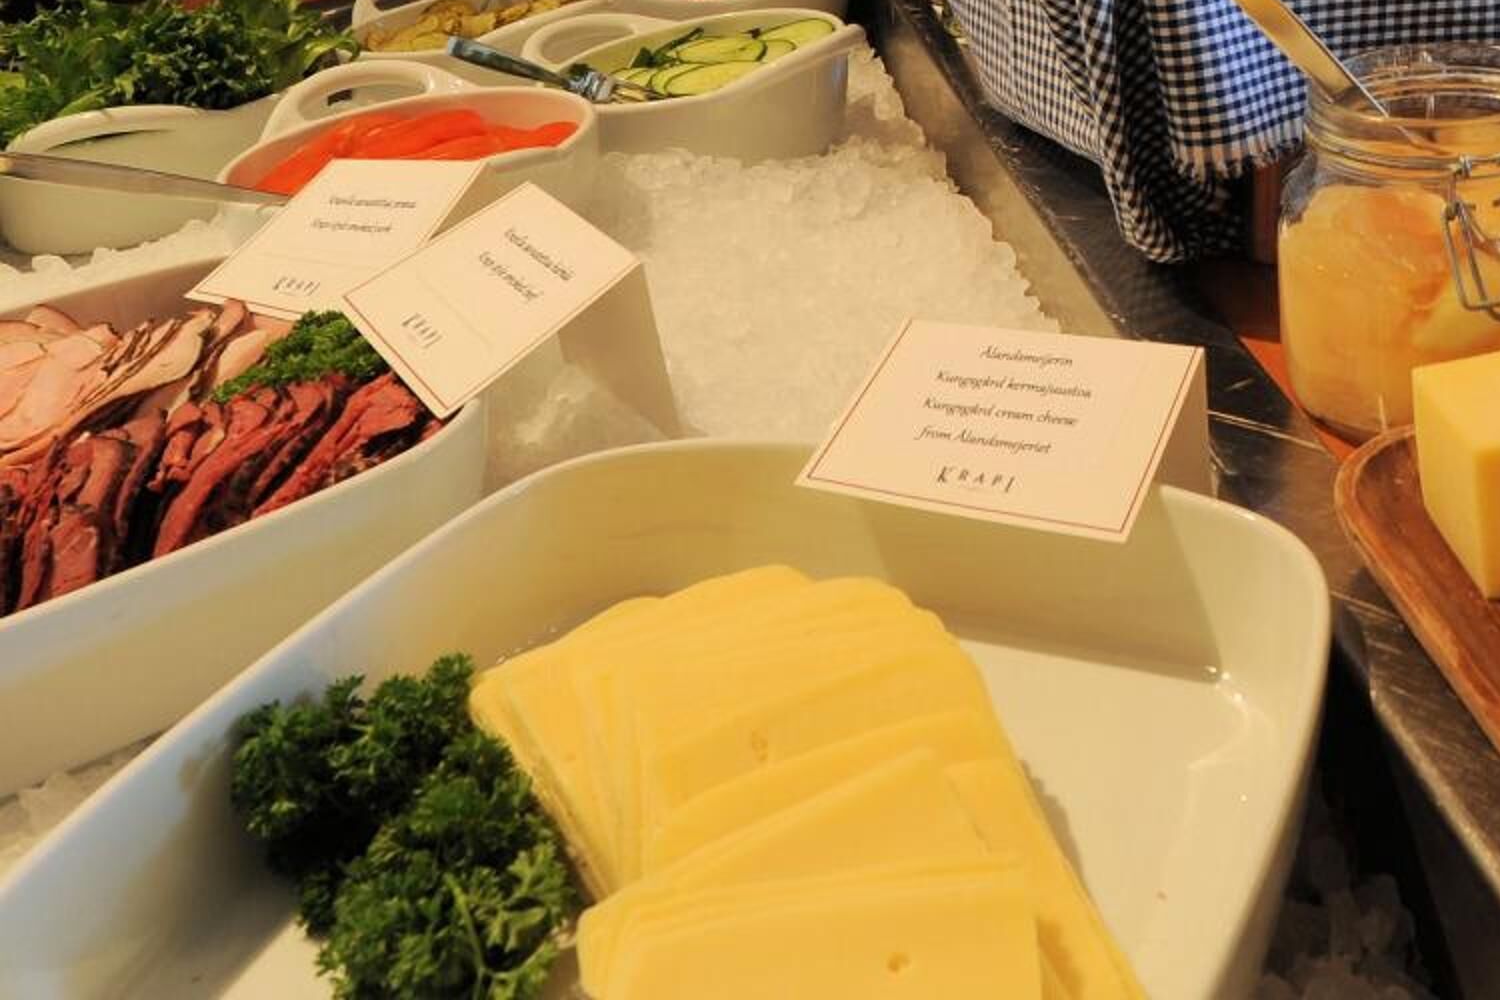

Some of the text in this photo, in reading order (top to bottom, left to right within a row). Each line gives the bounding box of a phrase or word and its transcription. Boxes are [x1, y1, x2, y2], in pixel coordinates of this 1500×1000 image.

[994, 408, 1035, 422] cream
[1036, 410, 1078, 426] cheese
[914, 425, 953, 441] from
[936, 465, 1016, 493] KRAPI
